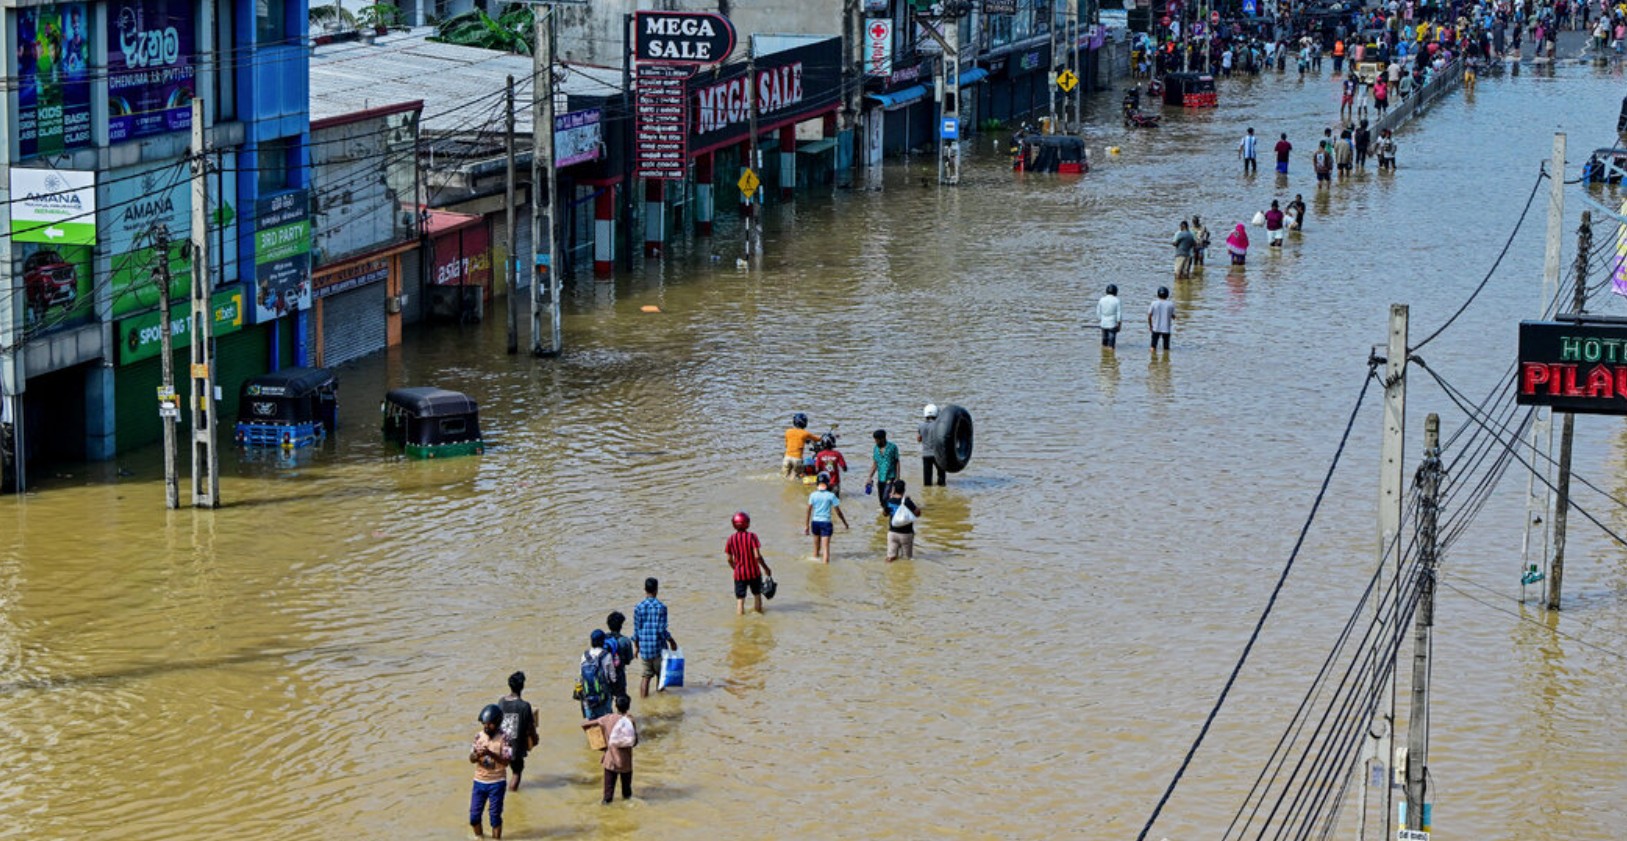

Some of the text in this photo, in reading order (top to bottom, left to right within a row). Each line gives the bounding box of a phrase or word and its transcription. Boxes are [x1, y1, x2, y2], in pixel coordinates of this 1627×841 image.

[646, 17, 716, 37] MEGA
[648, 40, 711, 60] SALE
[699, 62, 803, 135] MEGA SALE
[38, 105, 62, 119] KIDS
[64, 112, 89, 125] BASIC
[38, 125, 64, 137] CLASS
[64, 131, 90, 143] CLASS
[26, 192, 81, 205] AMANA
[124, 197, 174, 222] AMANA
[262, 224, 304, 249] 3RD PARTY
[140, 317, 185, 345] SPOING
